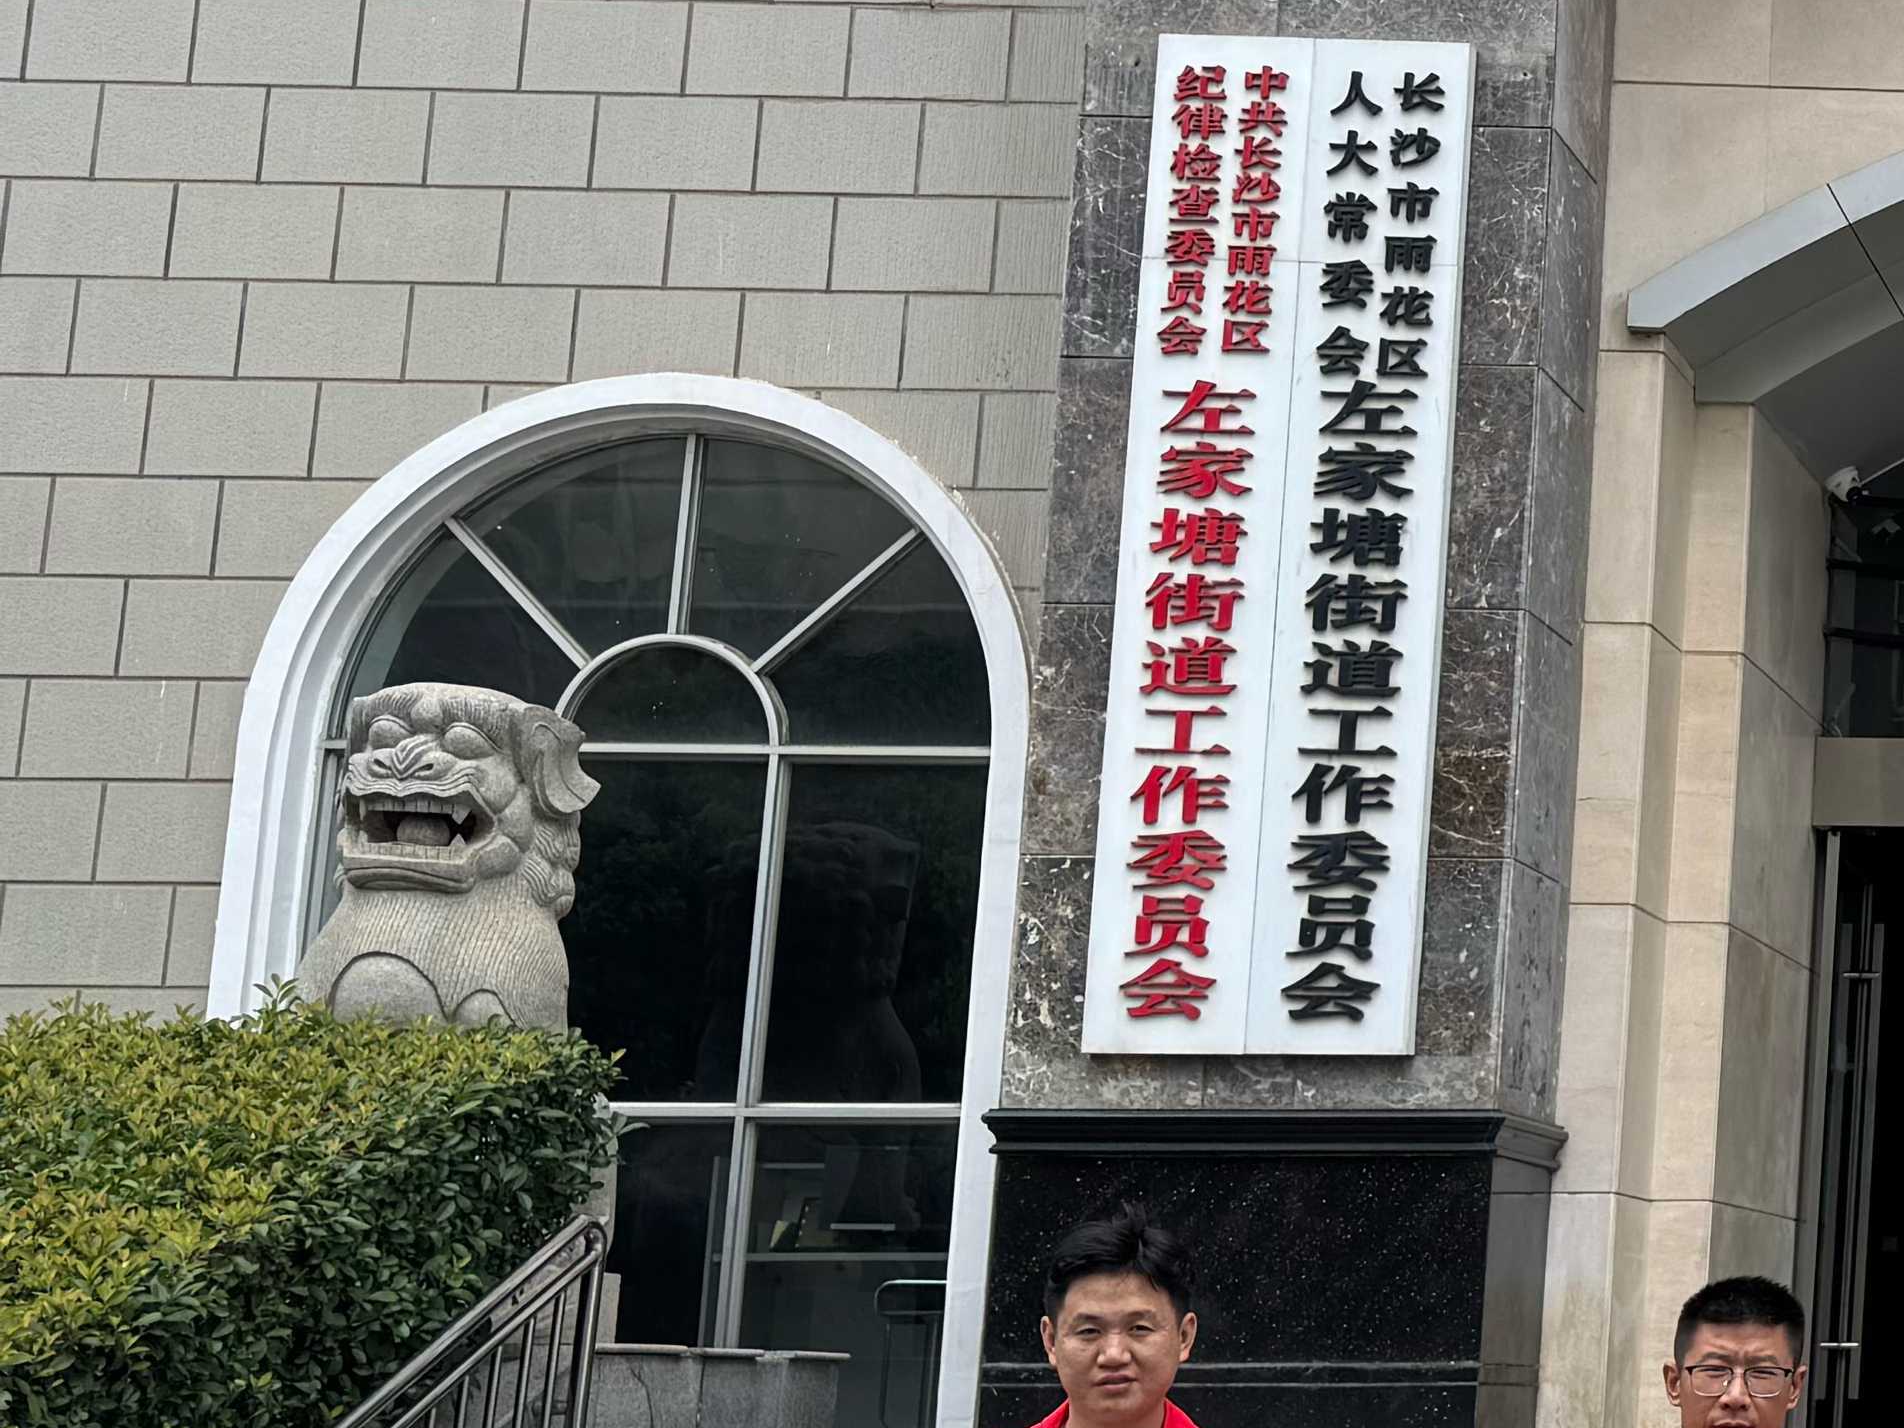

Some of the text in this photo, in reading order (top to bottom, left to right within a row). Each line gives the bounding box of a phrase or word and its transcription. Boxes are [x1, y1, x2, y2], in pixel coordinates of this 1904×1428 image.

[1157, 65, 1227, 355] 纪律检查委员会
[1222, 66, 1289, 353] 中共长沙市雨花区
[1317, 71, 1382, 377] 人大常委会
[1377, 71, 1446, 378] 长沙市雨花区
[1119, 379, 1252, 1021] 左家塘街道工作委员会
[1281, 379, 1419, 1022] 左家塘街道工作委员会
